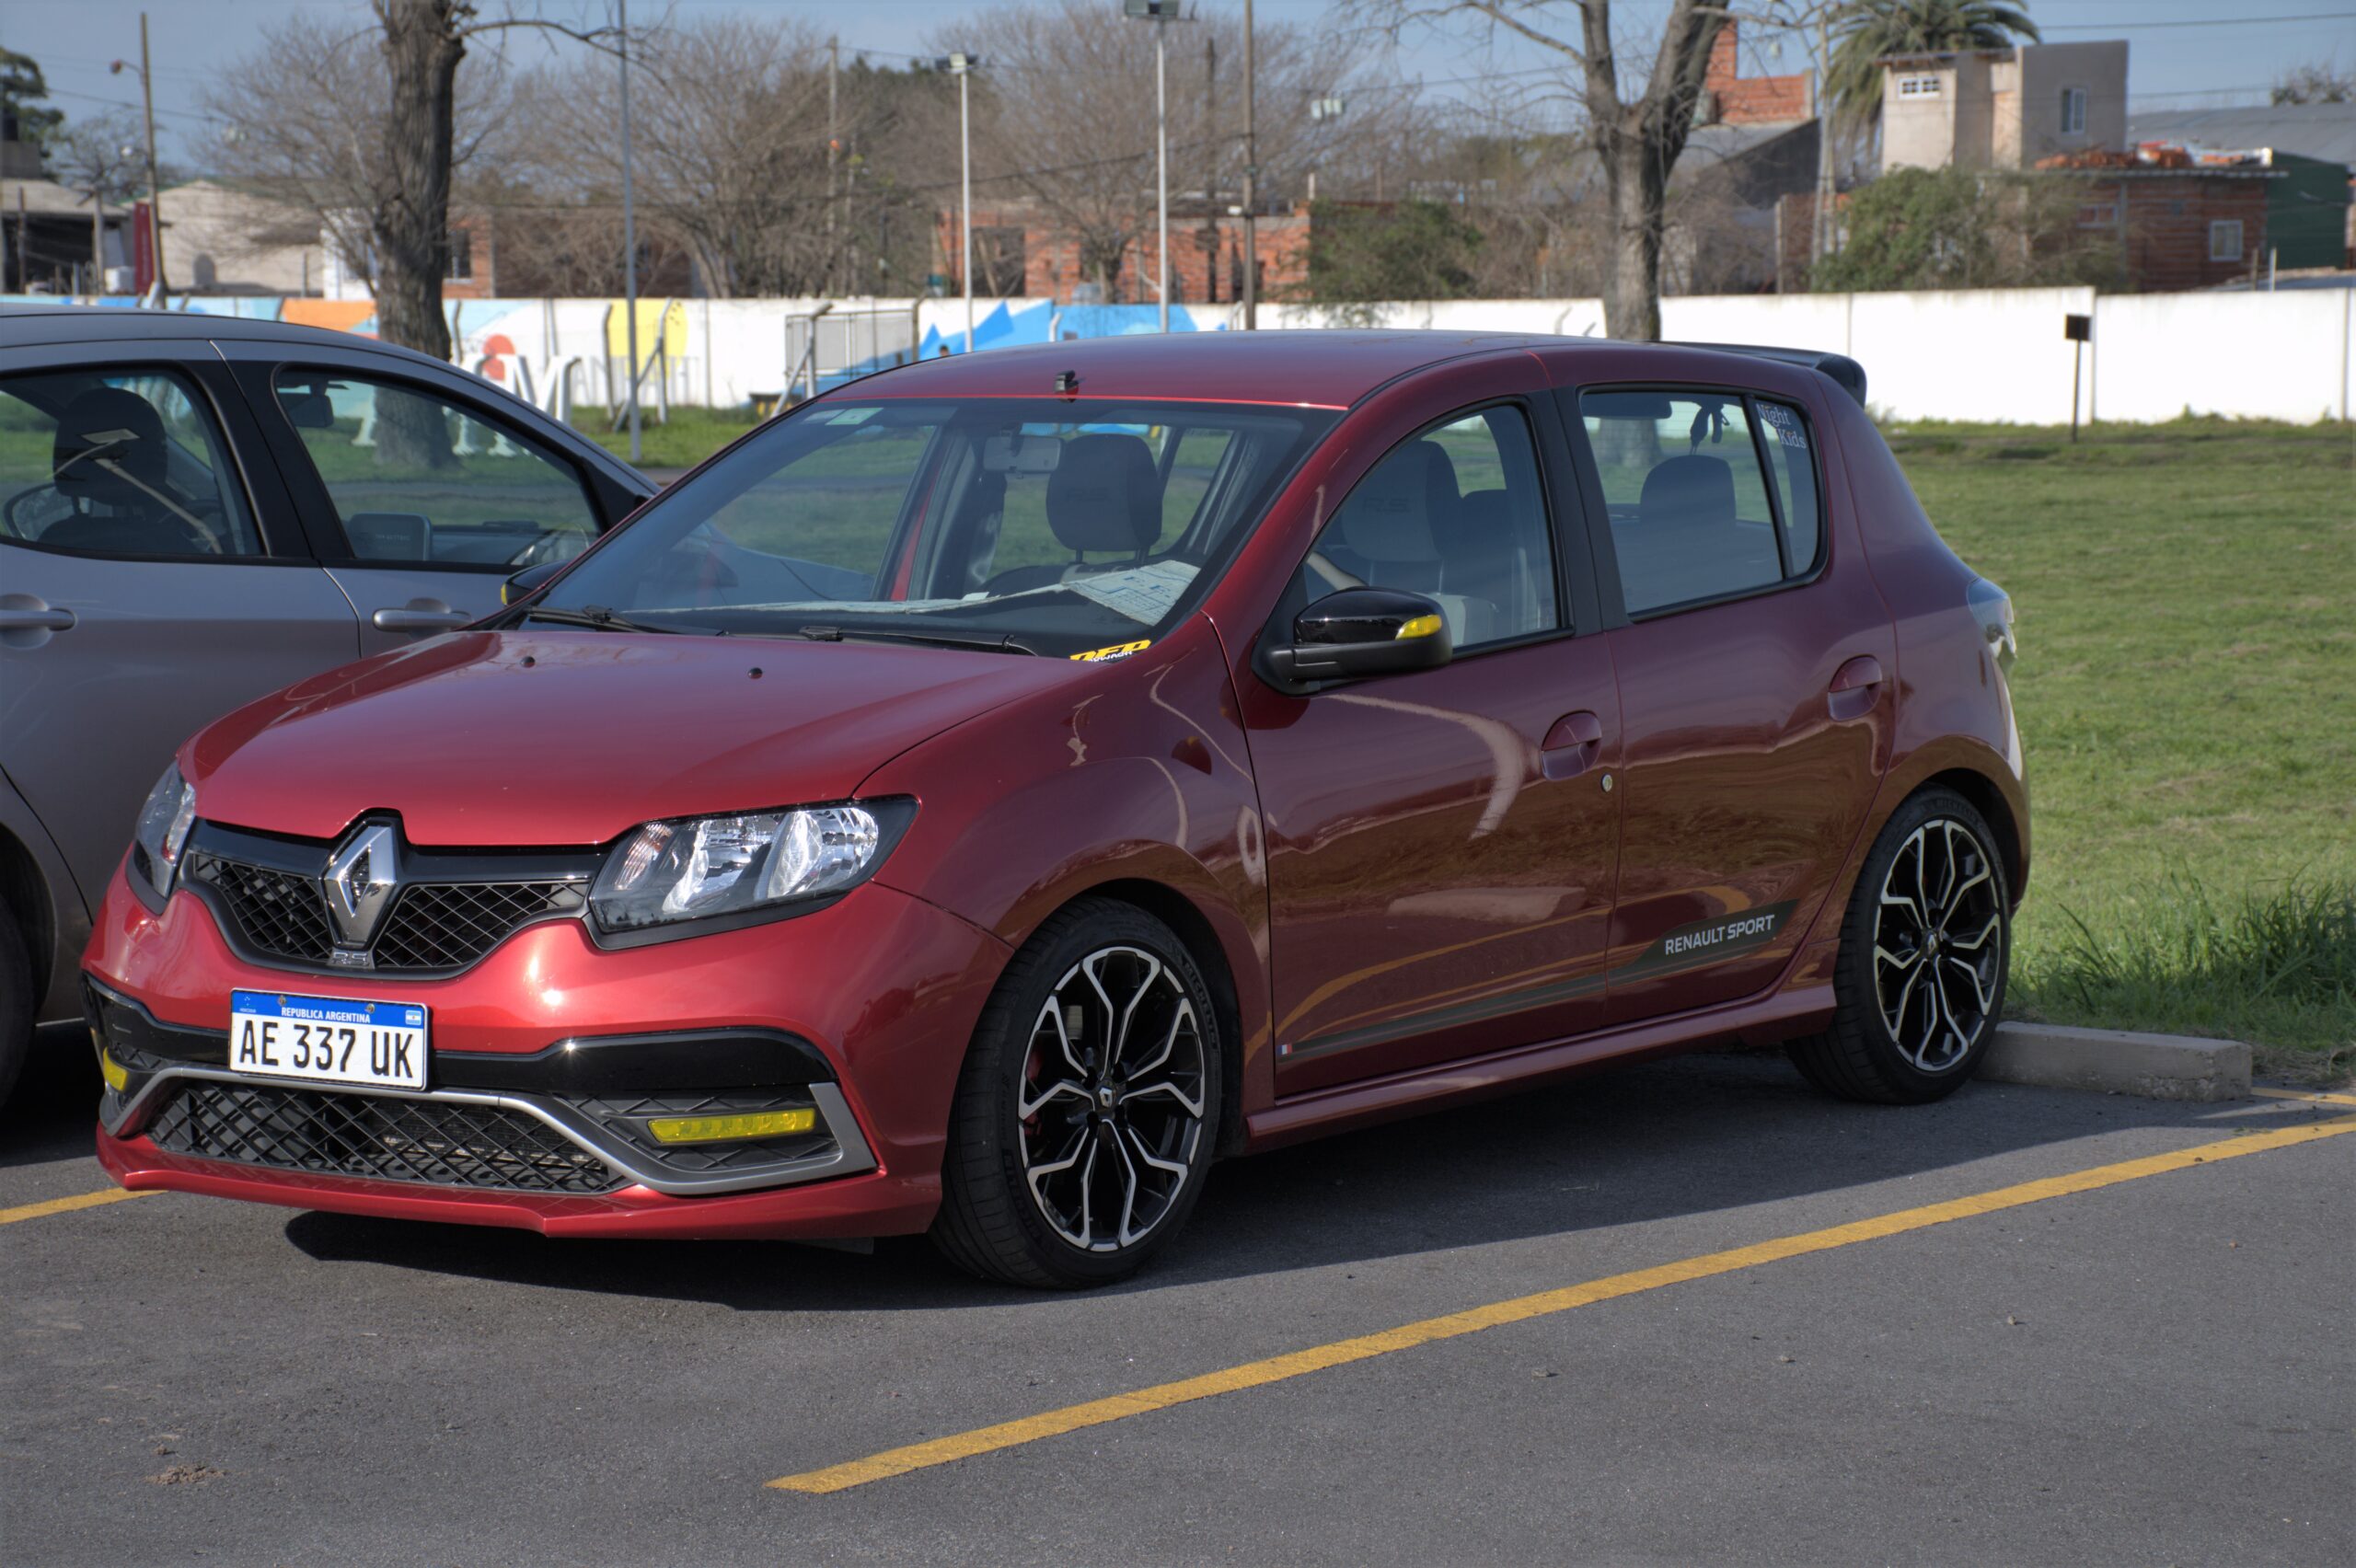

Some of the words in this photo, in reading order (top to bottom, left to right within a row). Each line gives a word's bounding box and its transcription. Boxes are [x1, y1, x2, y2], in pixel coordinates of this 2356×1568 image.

[1756, 403, 1791, 427] Night
[1777, 428, 1807, 449] Kids
[1665, 926, 1725, 955] RENAULT
[1727, 914, 1774, 940] SPORT
[281, 1007, 323, 1020] REPUBLICA
[325, 1012, 371, 1024] ARGENTINA
[239, 1020, 279, 1066] AE
[293, 1023, 356, 1073] 337
[371, 1031, 413, 1078] UK
